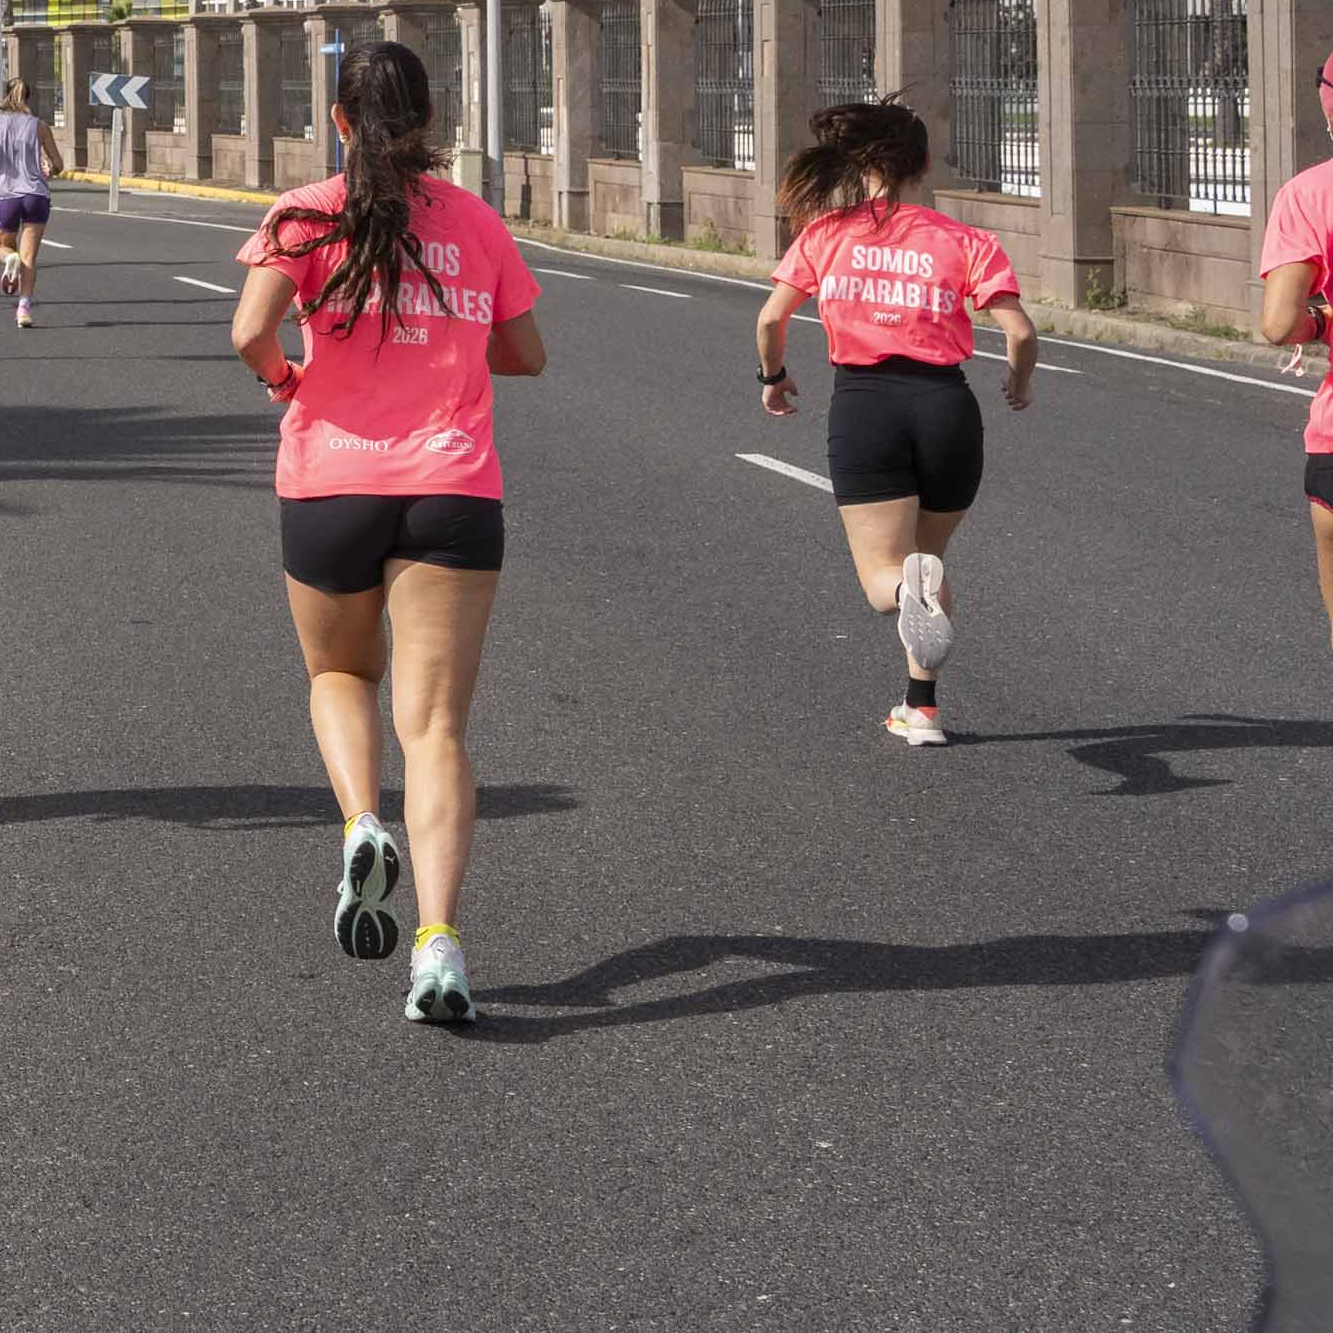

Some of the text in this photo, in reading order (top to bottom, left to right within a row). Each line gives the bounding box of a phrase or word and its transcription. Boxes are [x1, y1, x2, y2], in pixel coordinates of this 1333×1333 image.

[851, 244, 934, 278] SOMOS
[327, 282, 493, 325] RABLES
[820, 275, 956, 314] IMPARABLES
[873, 311, 902, 325] 2026
[392, 327, 428, 345] 2026
[329, 437, 389, 452] OYSHO
